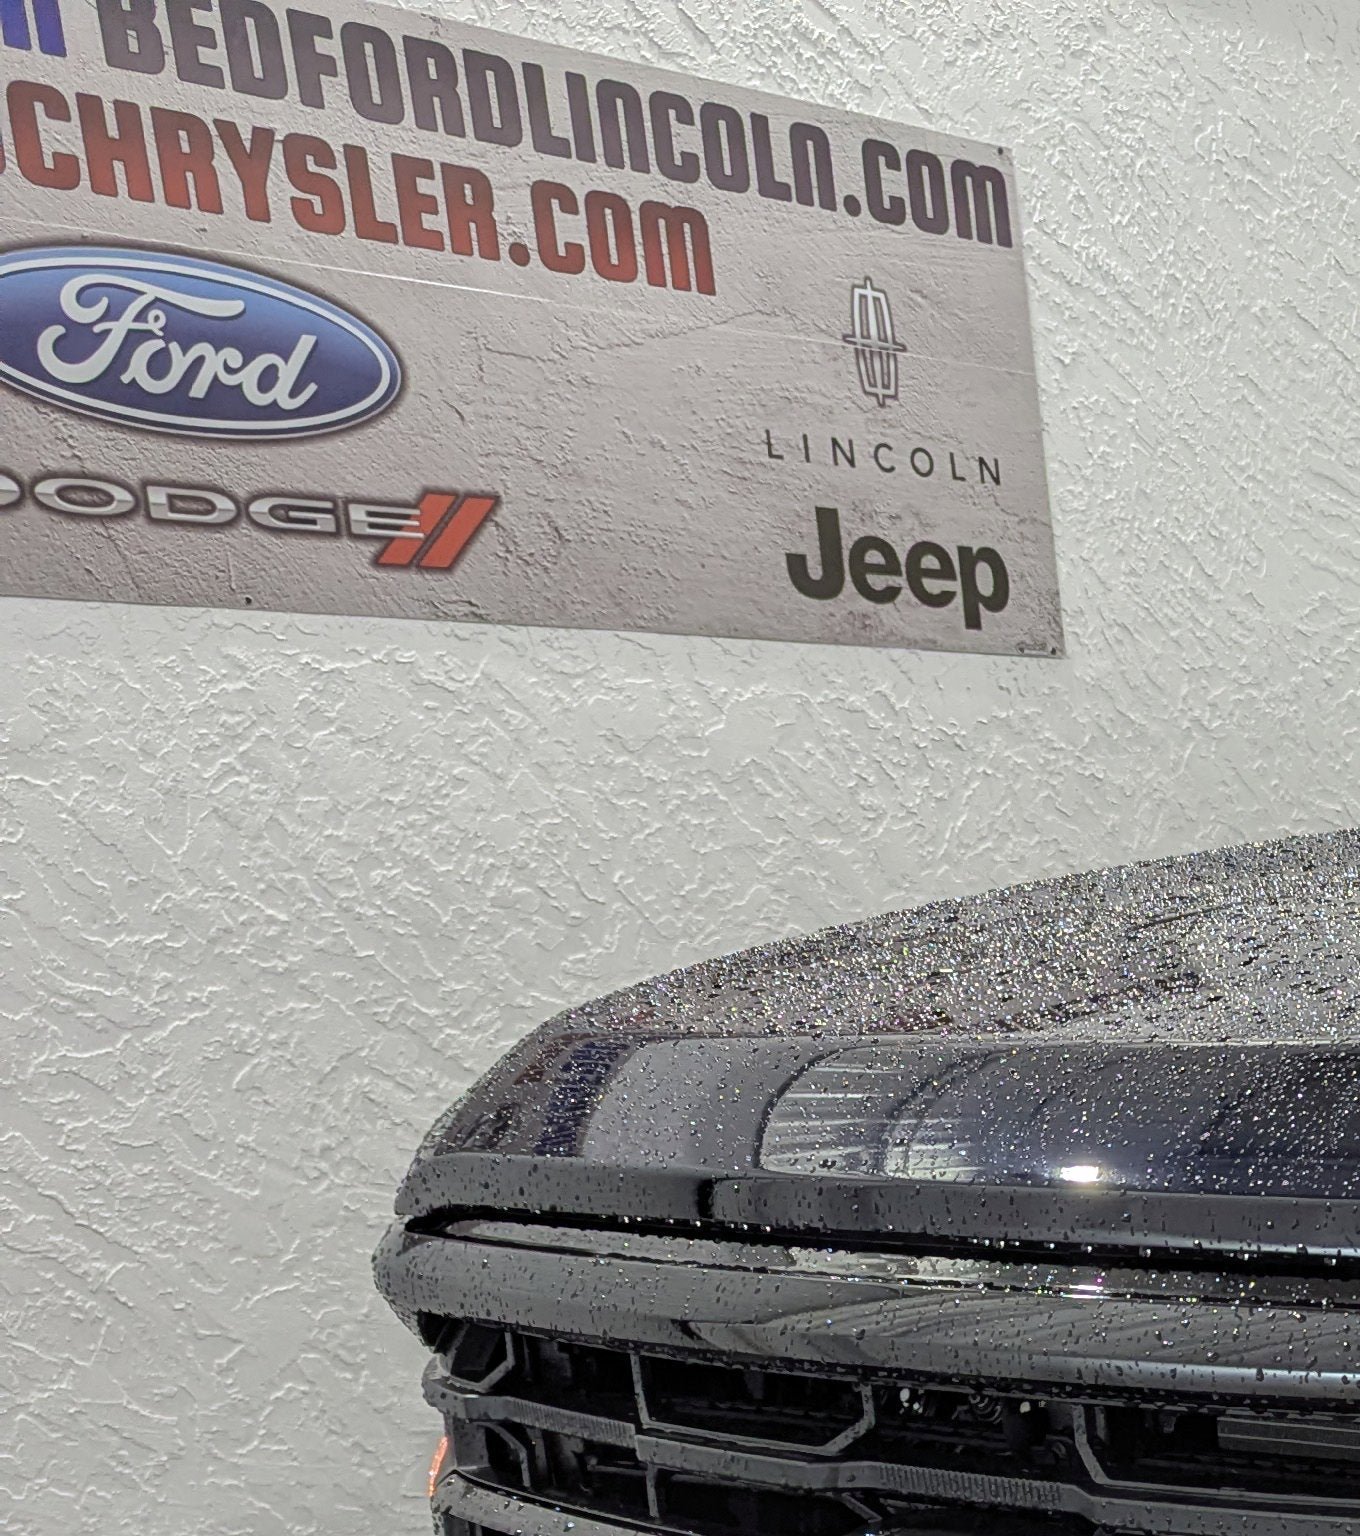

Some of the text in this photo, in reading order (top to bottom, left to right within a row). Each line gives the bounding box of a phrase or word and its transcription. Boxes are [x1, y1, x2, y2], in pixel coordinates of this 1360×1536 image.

[0, 79, 716, 297] CHRYSLER.COM
[36, 273, 319, 411] Ford
[0, 470, 425, 540] ODGE
[765, 429, 1001, 486] LINCOLN
[785, 506, 1010, 631] Jeep
